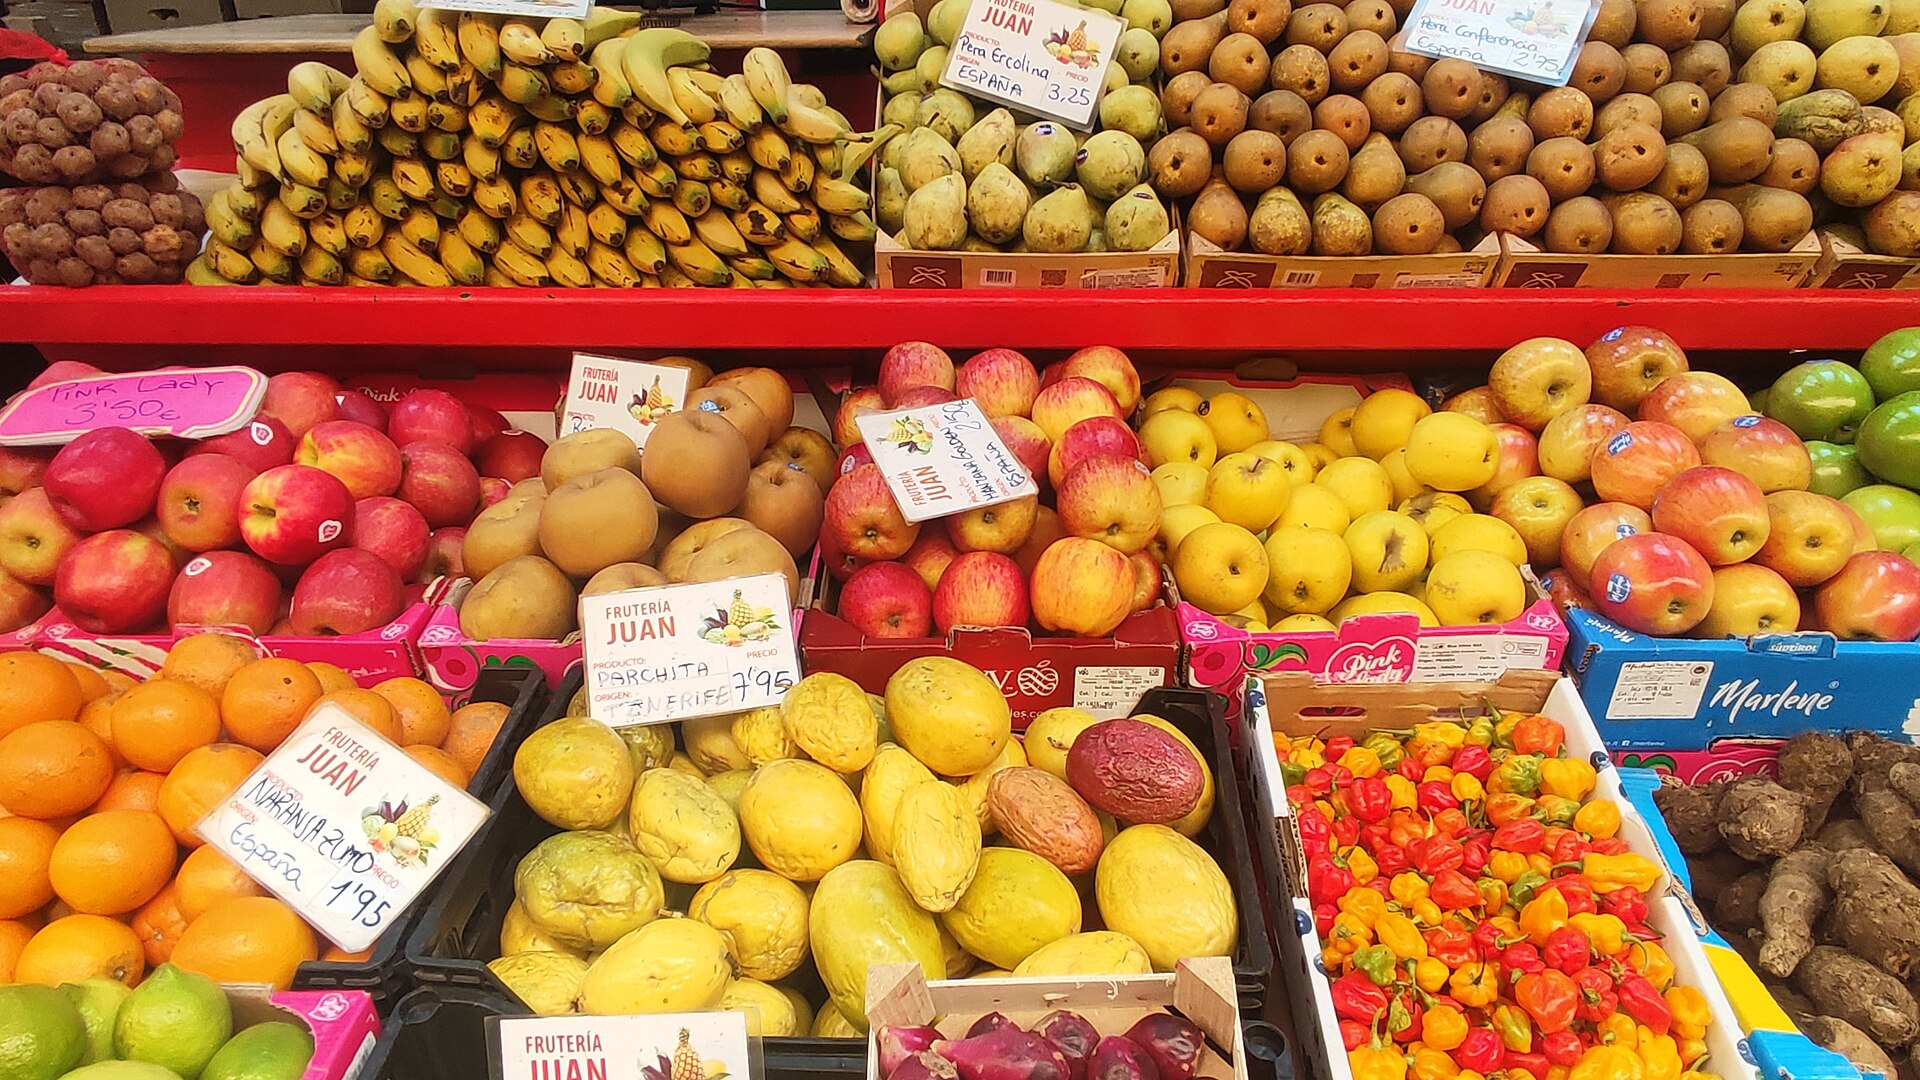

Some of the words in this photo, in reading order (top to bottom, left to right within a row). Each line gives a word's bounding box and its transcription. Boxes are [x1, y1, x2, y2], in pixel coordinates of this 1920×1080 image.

[981, 6, 1034, 36] JUAN
[1417, 35, 1487, 63] España
[1455, 24, 1539, 52] Conferencia
[991, 48, 1049, 81] Ercolina
[1066, 71, 1089, 83] PRECIO
[958, 64, 1024, 98] ESPAÑA
[1048, 83, 1091, 106] 3,25
[582, 366, 619, 382] FRUTERÍA
[578, 381, 618, 405] JUAN
[984, 441, 1026, 488] ESPAÑA
[912, 465, 953, 501] JUAN
[605, 598, 672, 620] FRUTERÍA
[606, 615, 676, 646] JUAN
[593, 656, 647, 670] PRODUCTO:
[746, 648, 778, 659] PRECIO
[1343, 643, 1402, 680] Pink
[594, 690, 633, 703] ORIGEN:
[732, 666, 794, 702] 7'95
[322, 726, 380, 772] FRUTERÍA
[296, 743, 367, 798] JUAN
[229, 822, 302, 893] España
[325, 880, 392, 928] 1'95
[525, 1031, 603, 1054] FRUTERÍA
[530, 1058, 608, 1080] JUAN
